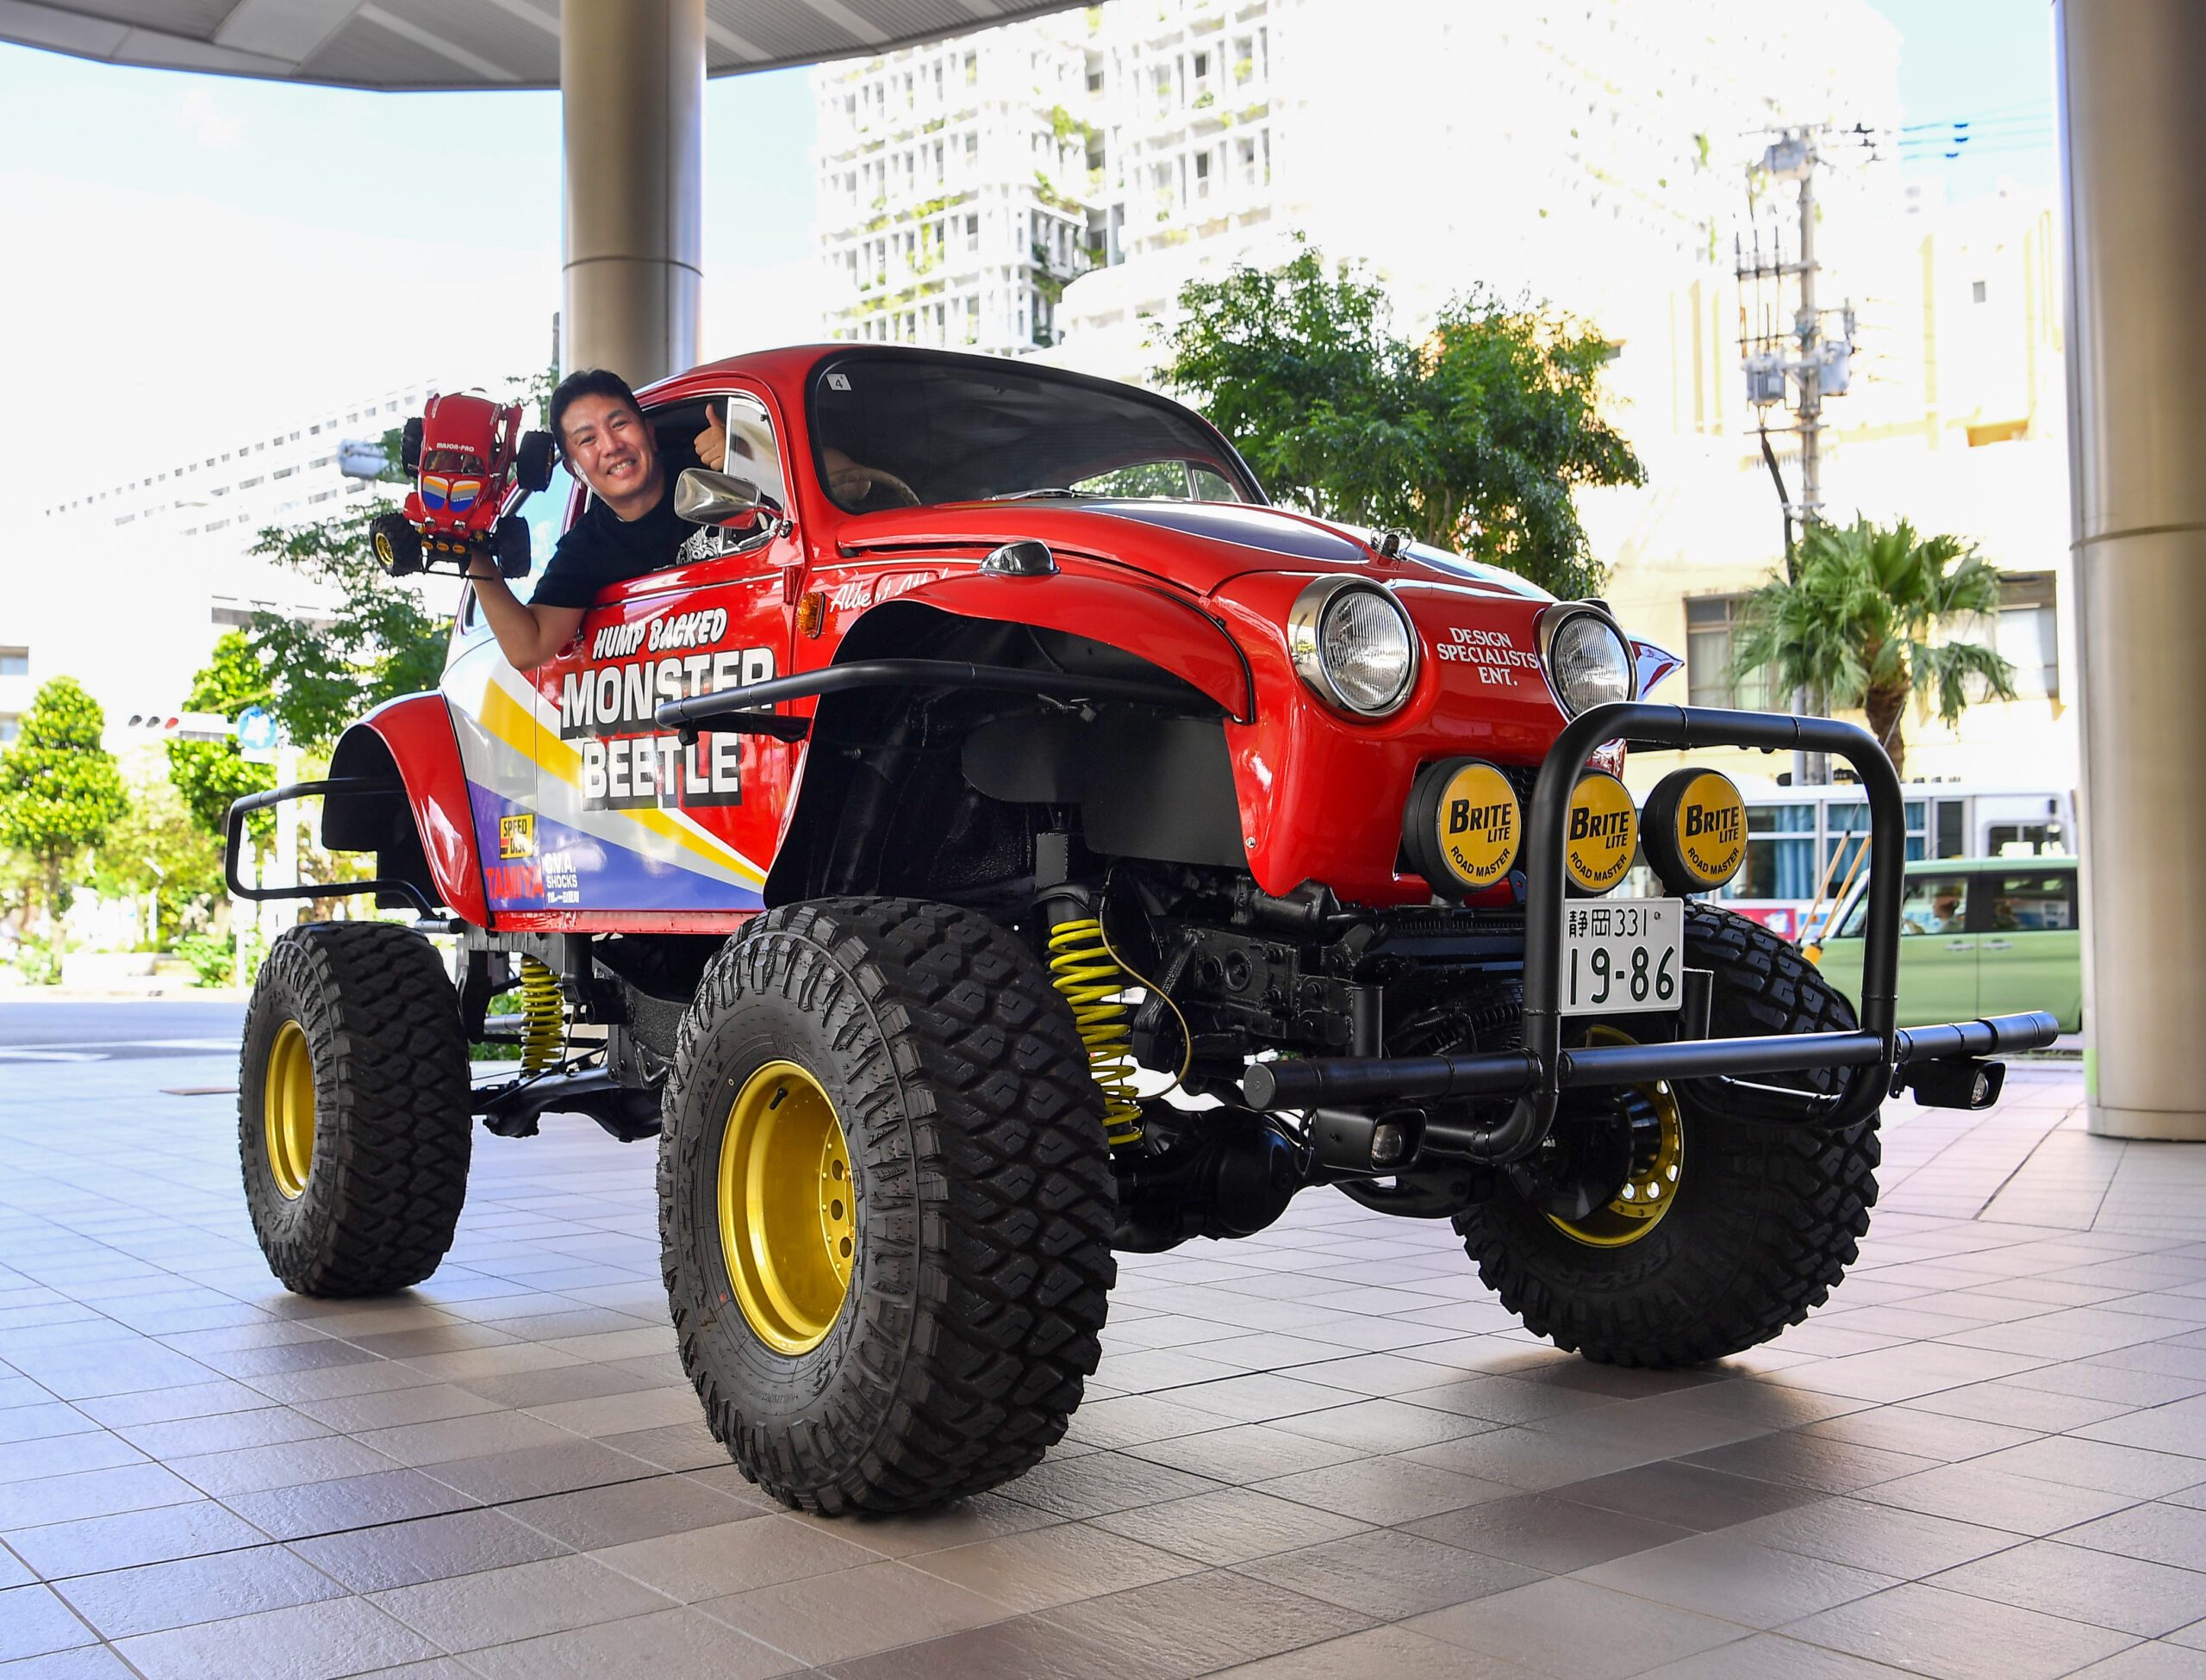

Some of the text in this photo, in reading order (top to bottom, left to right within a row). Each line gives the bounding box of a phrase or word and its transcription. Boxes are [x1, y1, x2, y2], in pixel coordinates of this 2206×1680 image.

[592, 607, 727, 660] HUMP BACKED
[1449, 627, 1513, 648] DESIGN
[1436, 643, 1540, 669] SPECIALISTS
[562, 647, 776, 730] MONSTER
[1477, 666, 1518, 686] ENT.
[583, 732, 740, 800] BEETLE
[503, 818, 527, 837] SPEED
[1449, 799, 1512, 834] BRITE
[1569, 807, 1630, 841] BRITE
[1686, 804, 1739, 837] BRITE
[1487, 826, 1511, 843] LITE
[1605, 833, 1628, 849] LITE
[1719, 828, 1739, 844] LITE
[1450, 845, 1511, 877] ROAD MASTER
[1570, 851, 1627, 881] ROAD MASTER
[1687, 847, 1739, 875] ROAD MASTER
[485, 865, 545, 899] TAMIYA
[546, 874, 578, 888] SHOCKS
[1570, 945, 1675, 1005] 19-86
